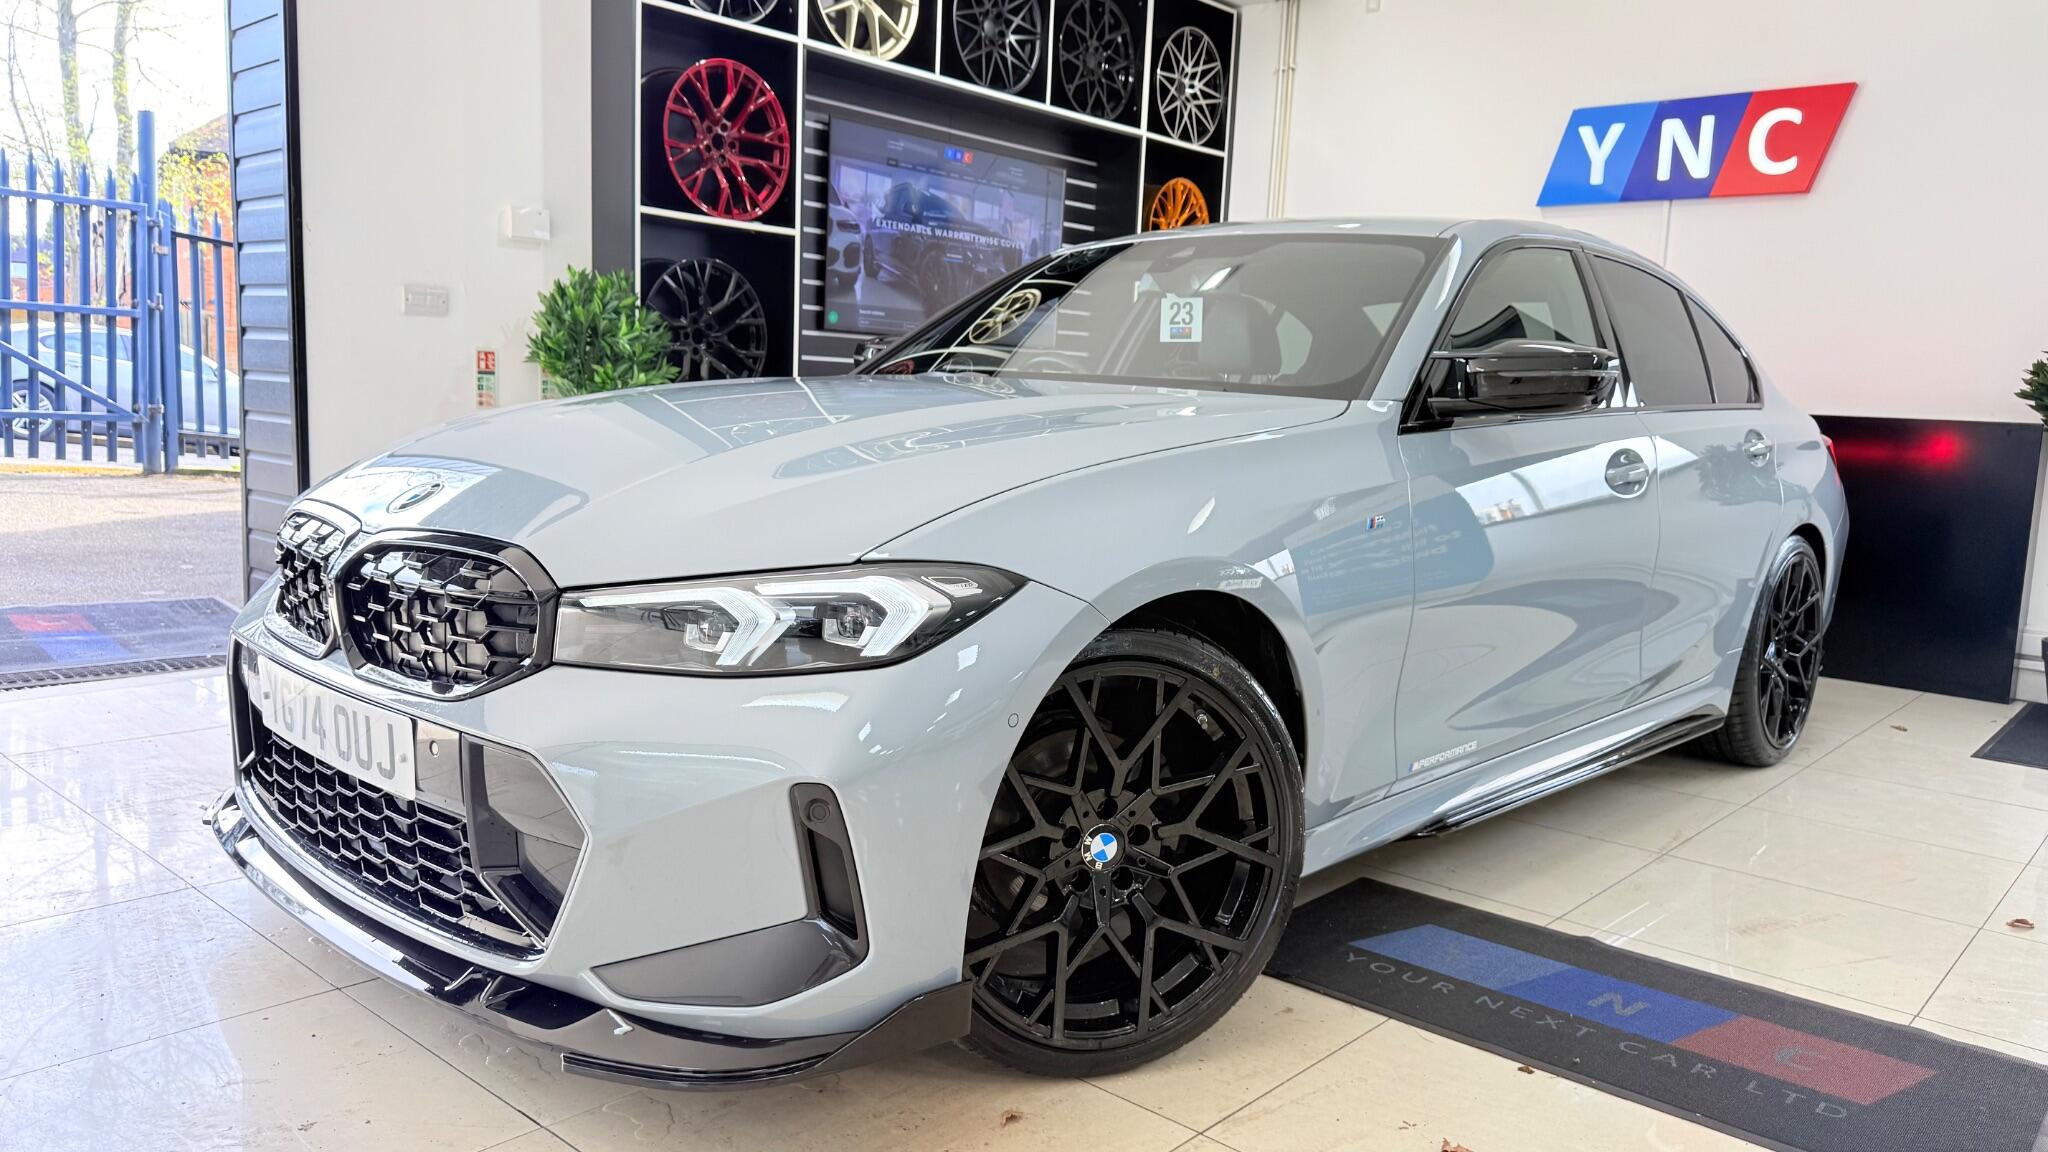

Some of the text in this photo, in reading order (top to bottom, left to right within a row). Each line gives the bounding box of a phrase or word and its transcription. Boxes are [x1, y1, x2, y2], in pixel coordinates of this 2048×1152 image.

[1577, 107, 1803, 185] YNC
[875, 219, 932, 236] EXTENDABLE
[1169, 302, 1194, 326] 23
[333, 703, 396, 780] OUJ
[1345, 951, 1847, 1118] YOUR NEXT CAR LTD
